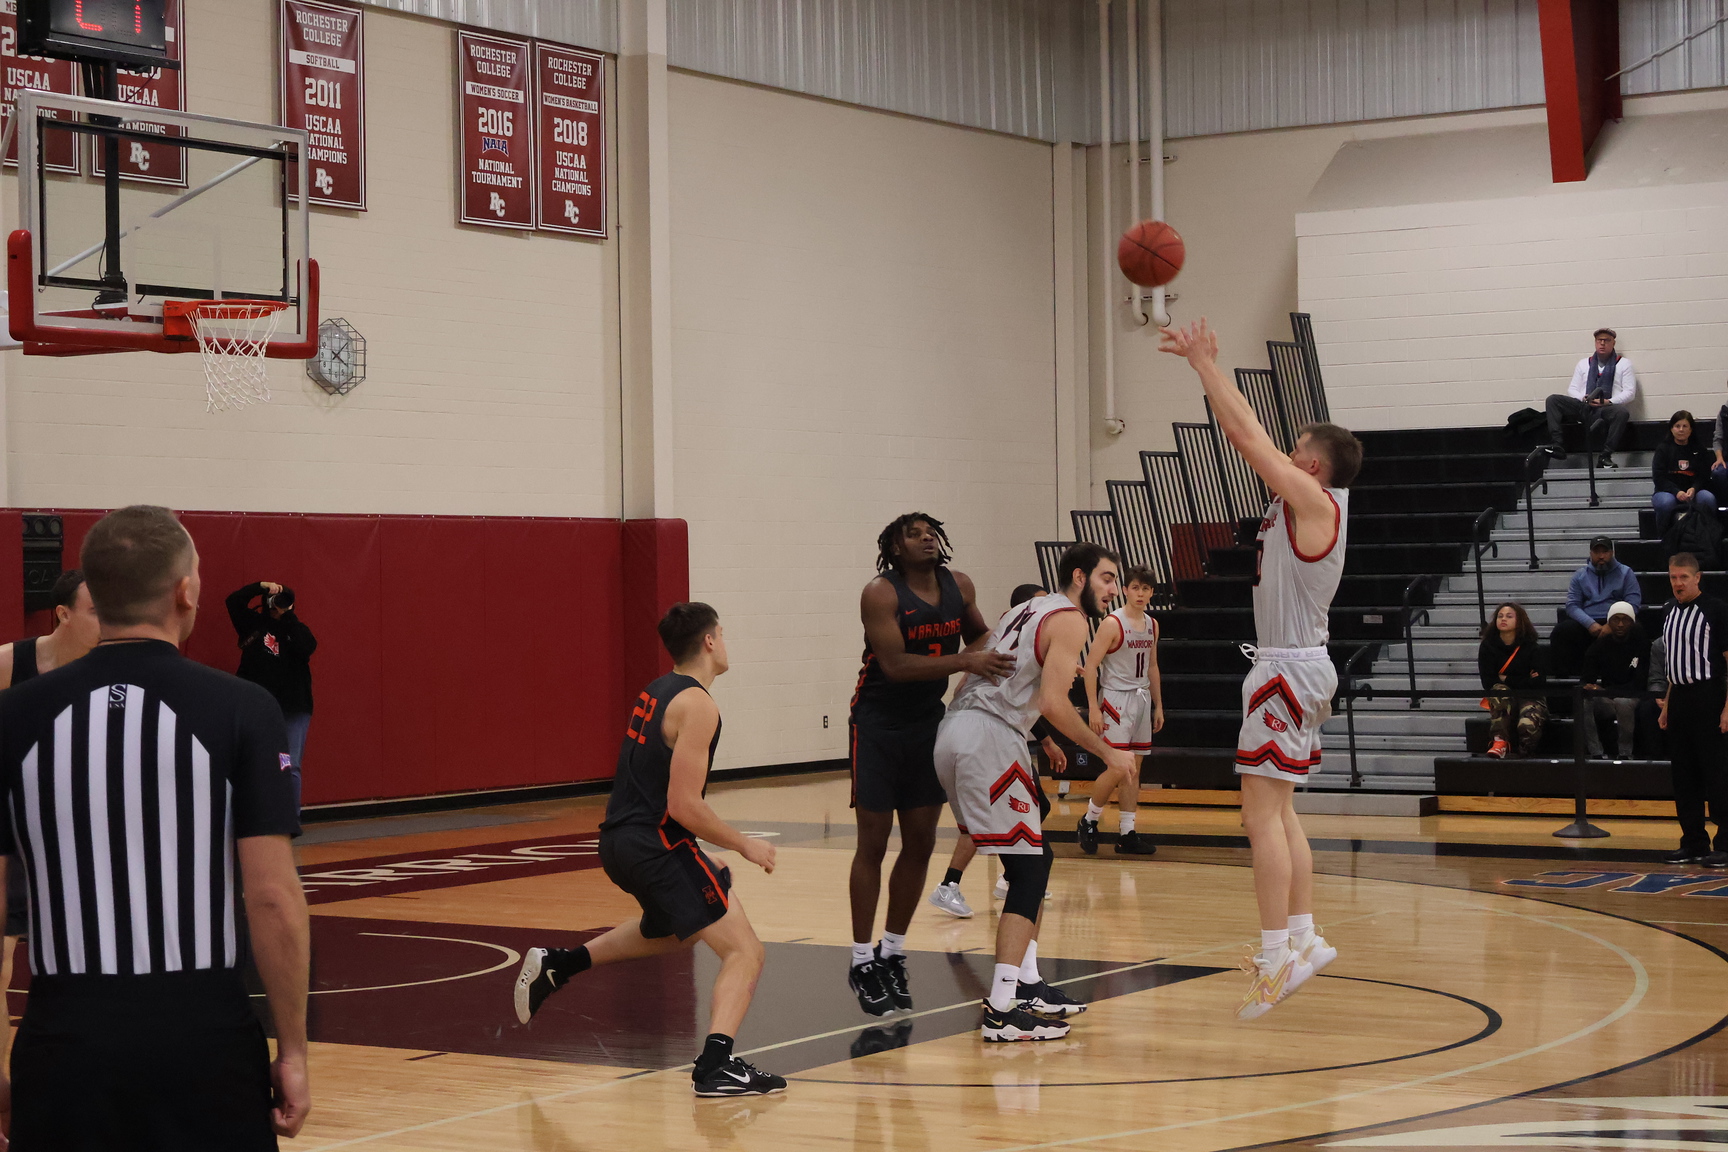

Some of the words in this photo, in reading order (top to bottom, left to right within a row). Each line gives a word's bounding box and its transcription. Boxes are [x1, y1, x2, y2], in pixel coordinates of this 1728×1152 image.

[296, 10, 348, 33] ROCHESTER
[303, 28, 342, 47] COLLEGE
[306, 54, 340, 69] SOFTBALL
[470, 44, 517, 64] ROCHESTER
[477, 60, 511, 78] COLLEGE
[548, 57, 592, 76] ROCHESTER
[7, 67, 51, 91] USCAA
[554, 72, 587, 89] COLLEGE
[117, 84, 160, 107] USCAA
[305, 77, 342, 109] 2011
[470, 83, 496, 97] WOMEN'S
[497, 89, 520, 101] SOCCER
[543, 94, 566, 107] WOMEN'S
[566, 98, 598, 112] BASKETBALL
[305, 113, 342, 135] USCAA
[478, 106, 513, 137] 2016
[554, 117, 588, 146] 2018
[308, 132, 344, 149] ATIONAL
[482, 136, 509, 157] NAIA
[130, 142, 150, 171] RC
[308, 147, 347, 165] HAMPIONS
[478, 158, 515, 174] NATIONAL
[556, 150, 587, 169] USCAA
[315, 168, 334, 195] RC
[471, 171, 523, 188] TOURNAMENT
[554, 167, 589, 182] NATIONAL
[552, 180, 591, 196] CHAMPIONS
[489, 191, 506, 217] RC
[564, 199, 580, 224] RC
[908, 618, 961, 641] WARRIORS
[1136, 651, 1145, 678] 11
[626, 691, 658, 745] 22
[1017, 801, 1030, 813] RU
